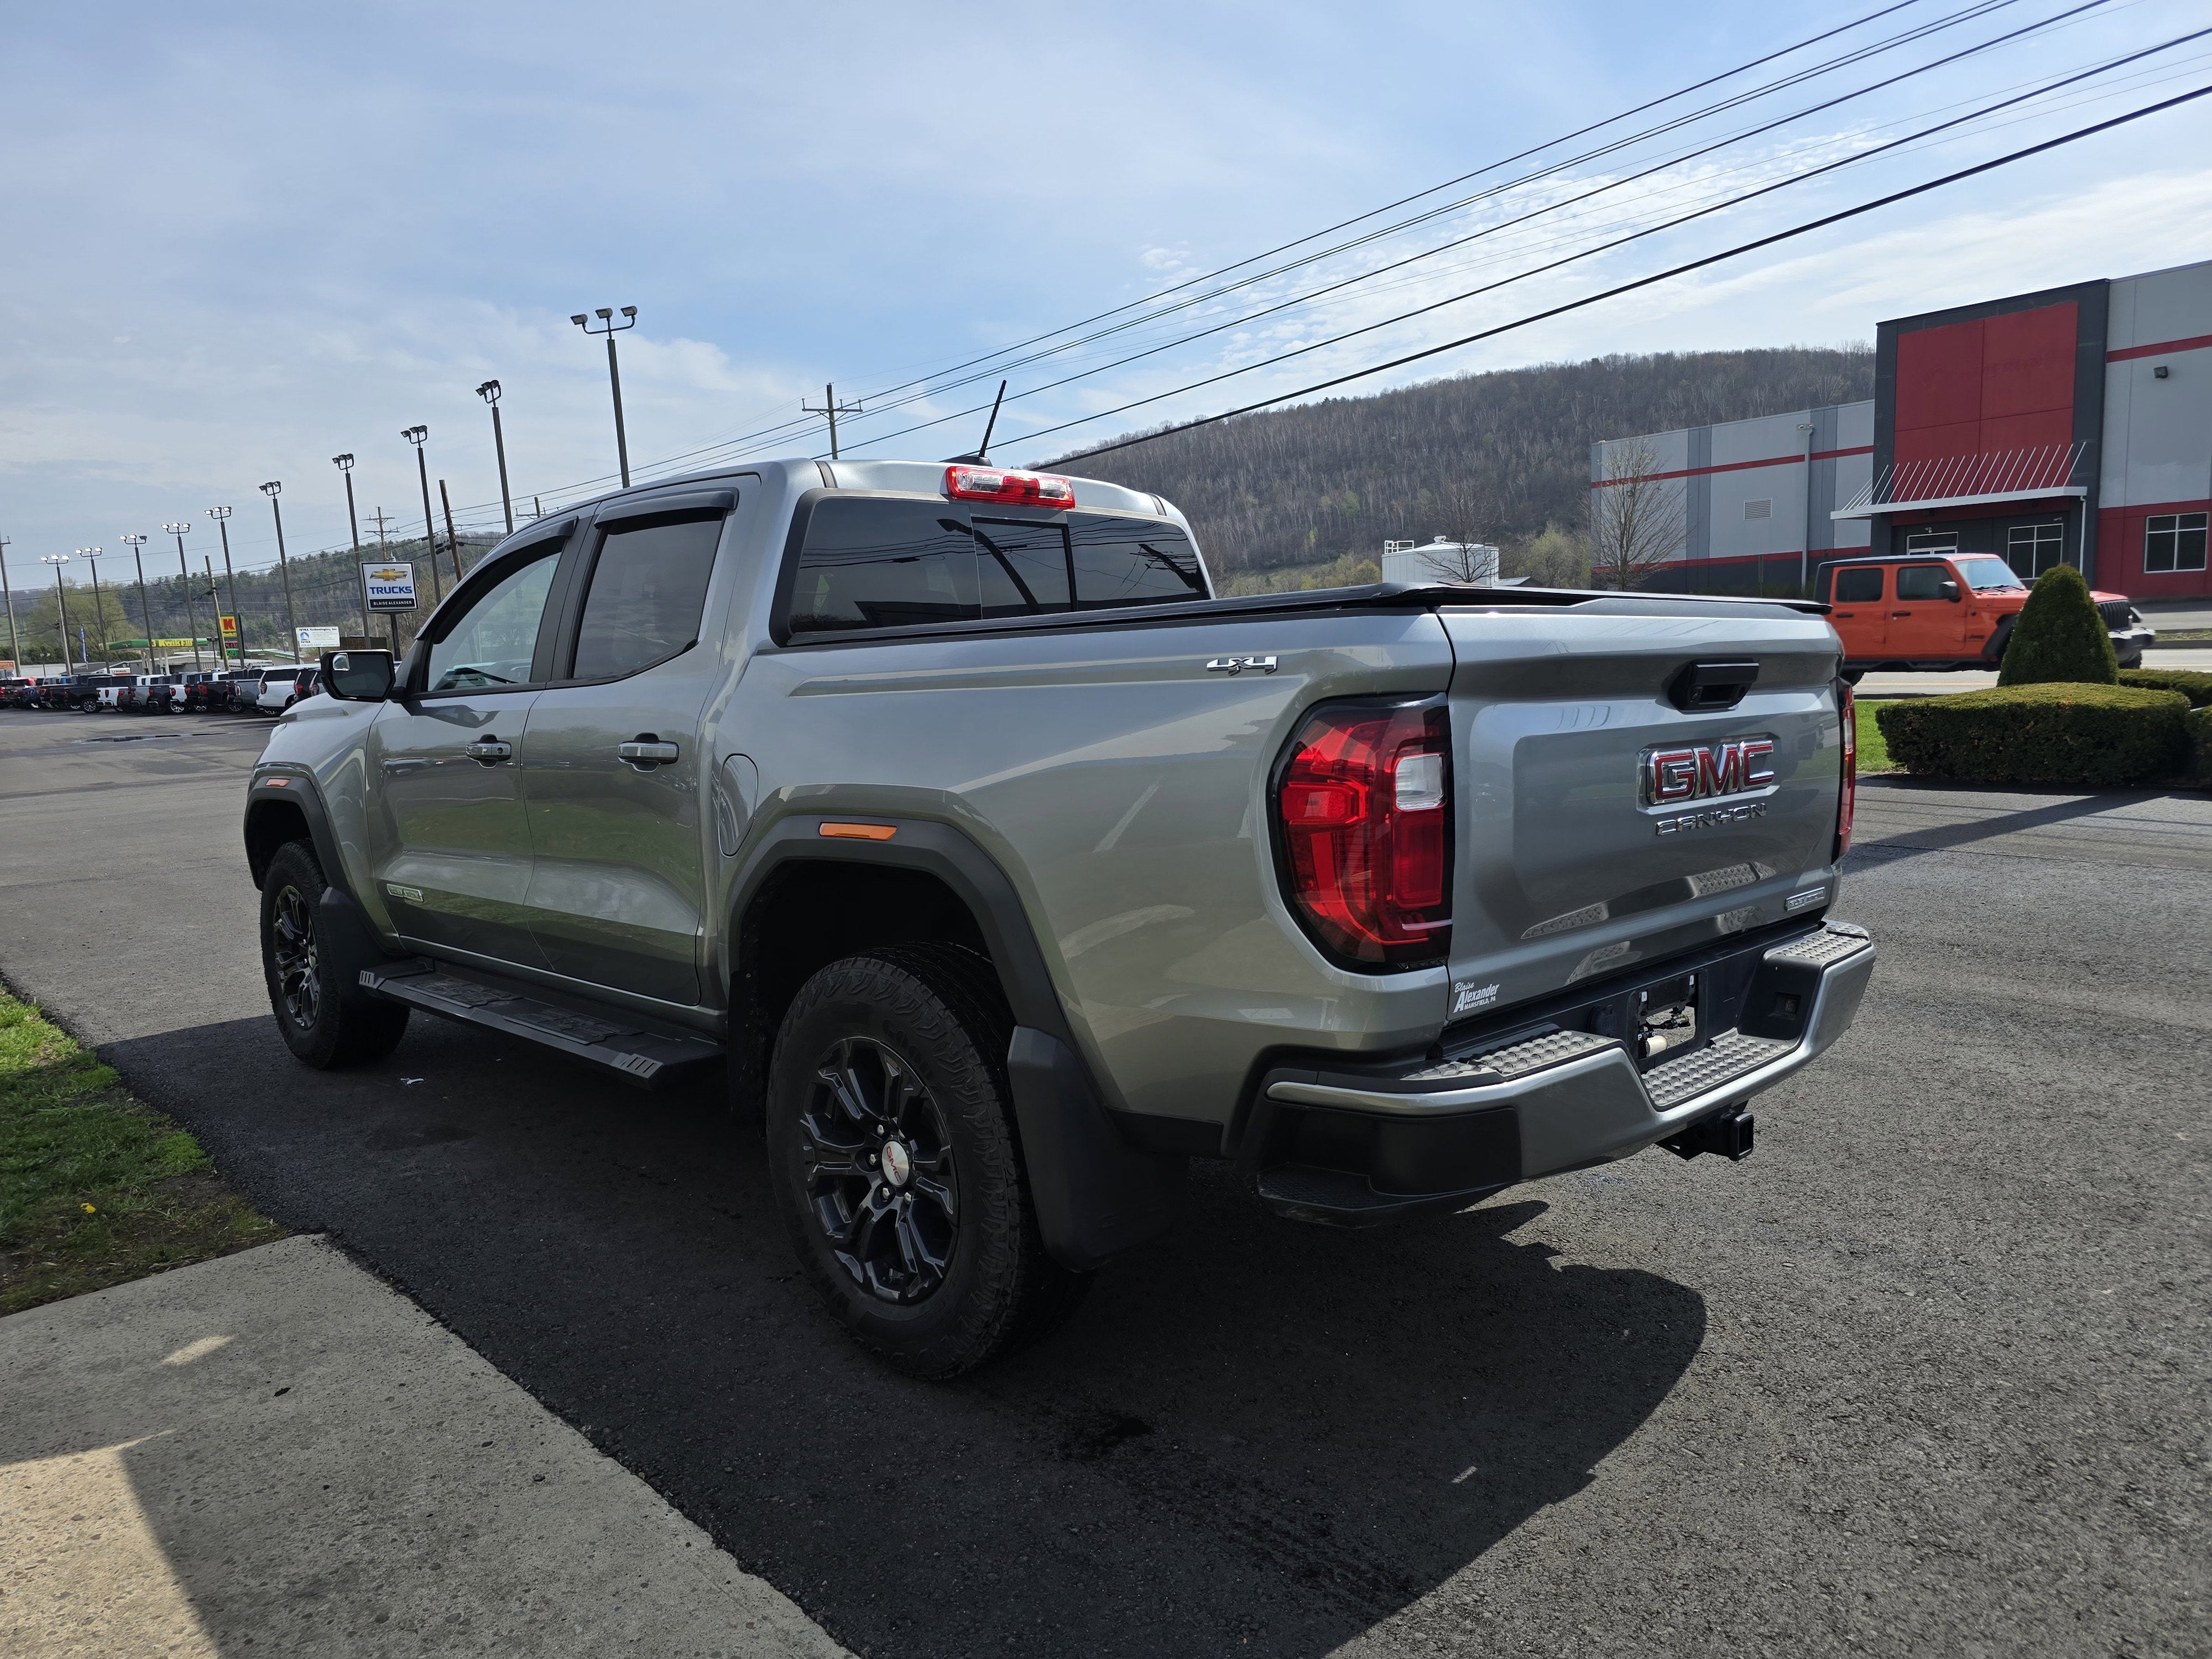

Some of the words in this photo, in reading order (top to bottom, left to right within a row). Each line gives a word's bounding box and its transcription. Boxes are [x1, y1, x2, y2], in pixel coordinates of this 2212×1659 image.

[223, 619, 235, 630] K
[1647, 740, 1775, 805] GMC
[1656, 802, 1767, 836] CANYON
[1453, 983, 1500, 1013] Alexander
[1454, 982, 1474, 993] Blaise
[1464, 998, 1490, 1010] MANSFIELD,
[886, 1145, 902, 1182] GMC
